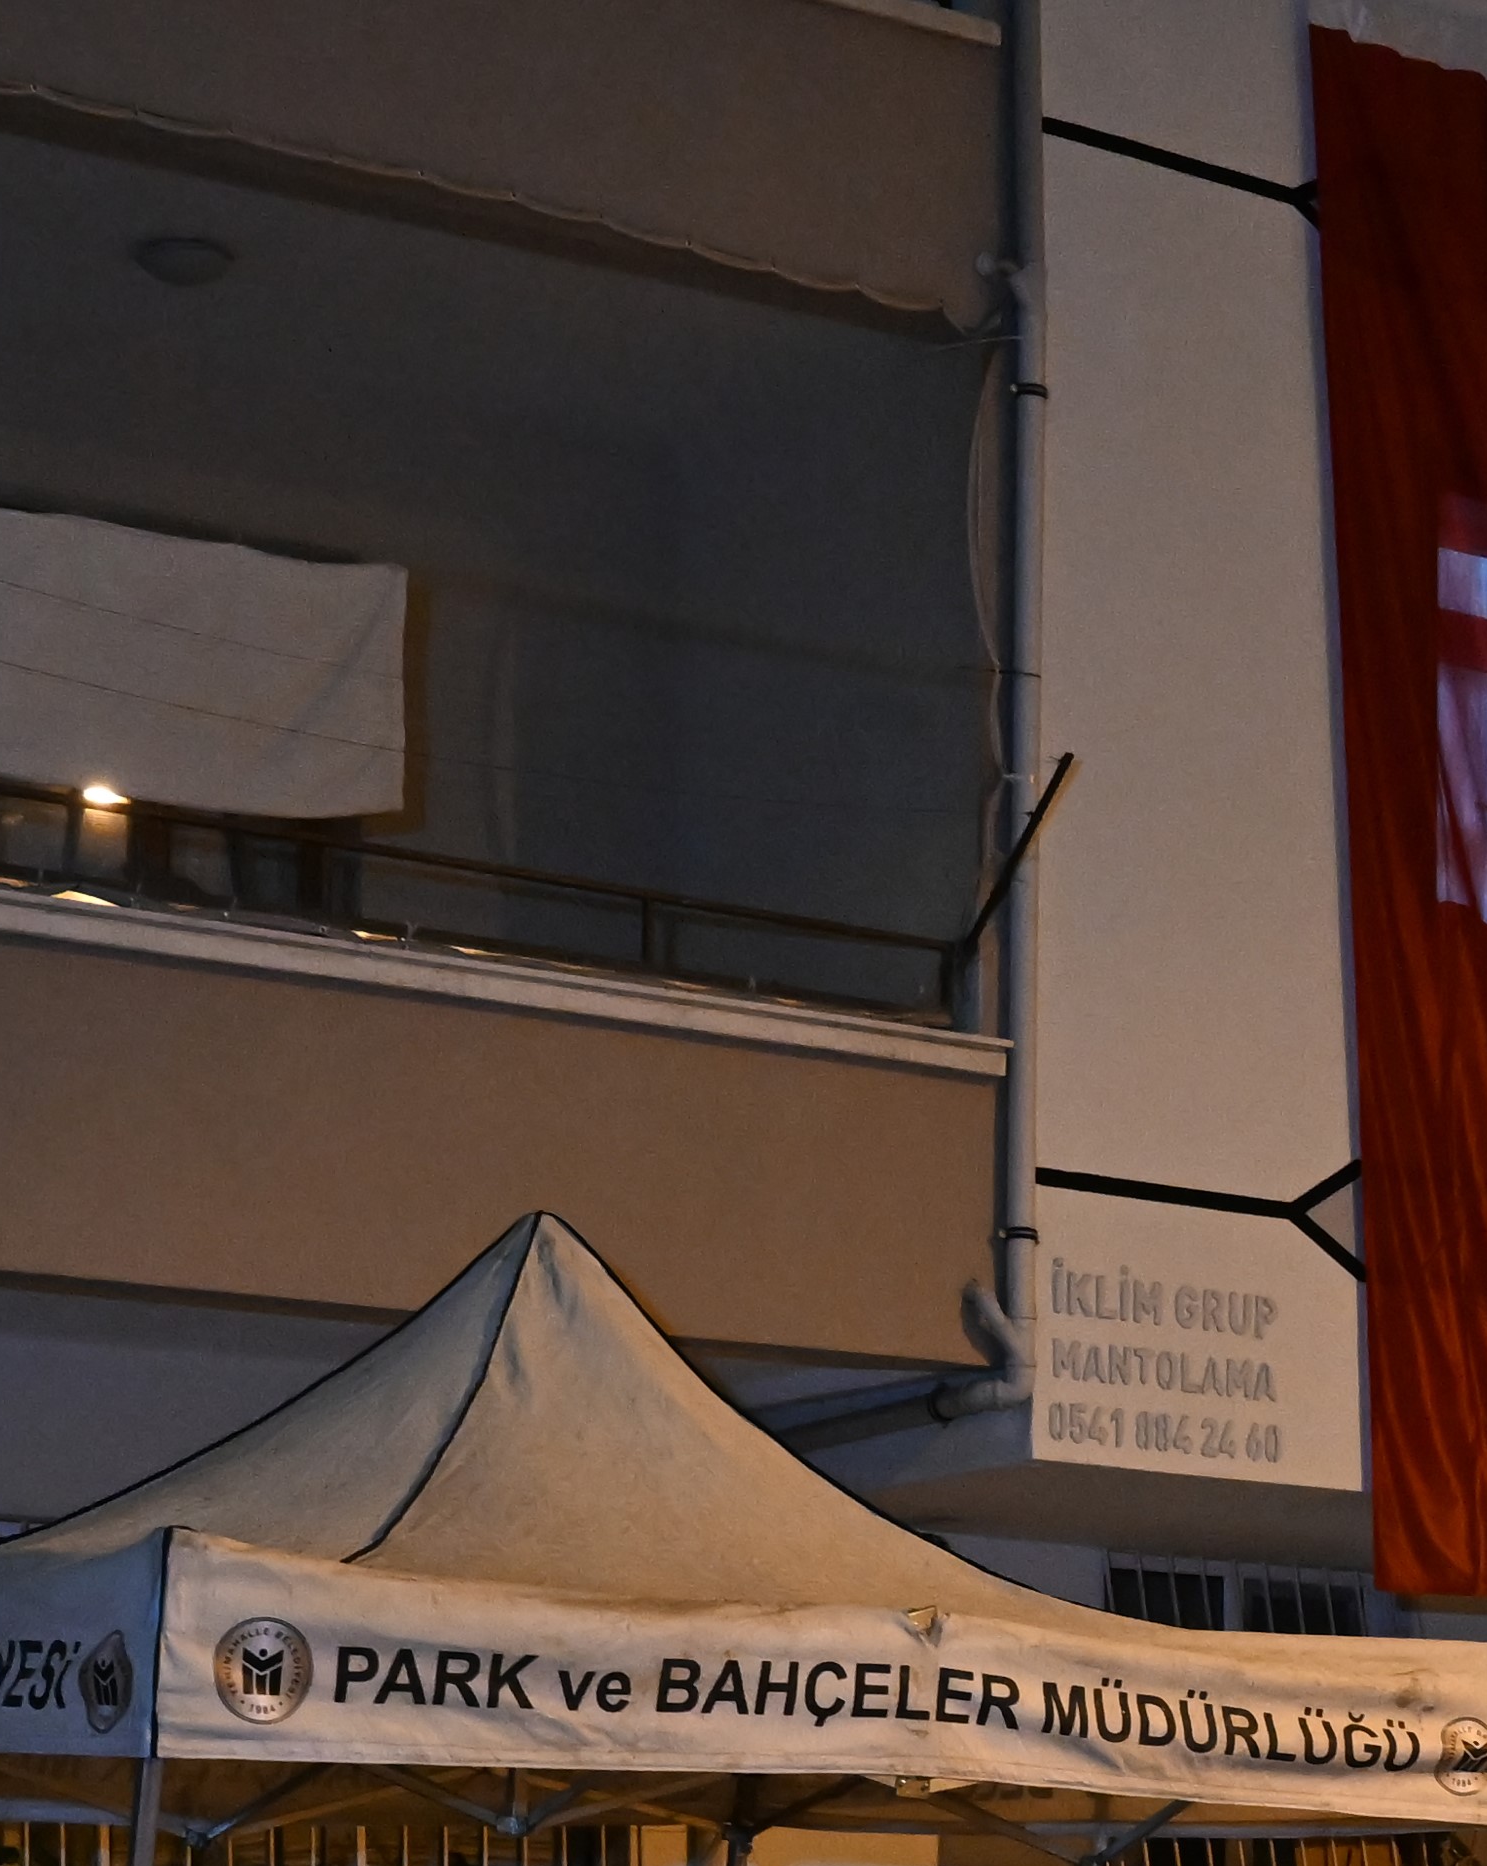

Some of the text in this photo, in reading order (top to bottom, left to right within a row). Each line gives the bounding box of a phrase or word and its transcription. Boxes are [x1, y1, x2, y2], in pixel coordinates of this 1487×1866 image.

[1051, 1257, 1277, 1340] İKLİM GRUP
[1051, 1337, 1276, 1402] MANTOLAMA
[1048, 1402, 1123, 1448] 0541
[333, 1646, 537, 1709] PARK
[558, 1669, 631, 1713] ve
[655, 1658, 1019, 1730] BAHÇELER
[1041, 1678, 1421, 1772] MÜDÜRLÜĞÜ
